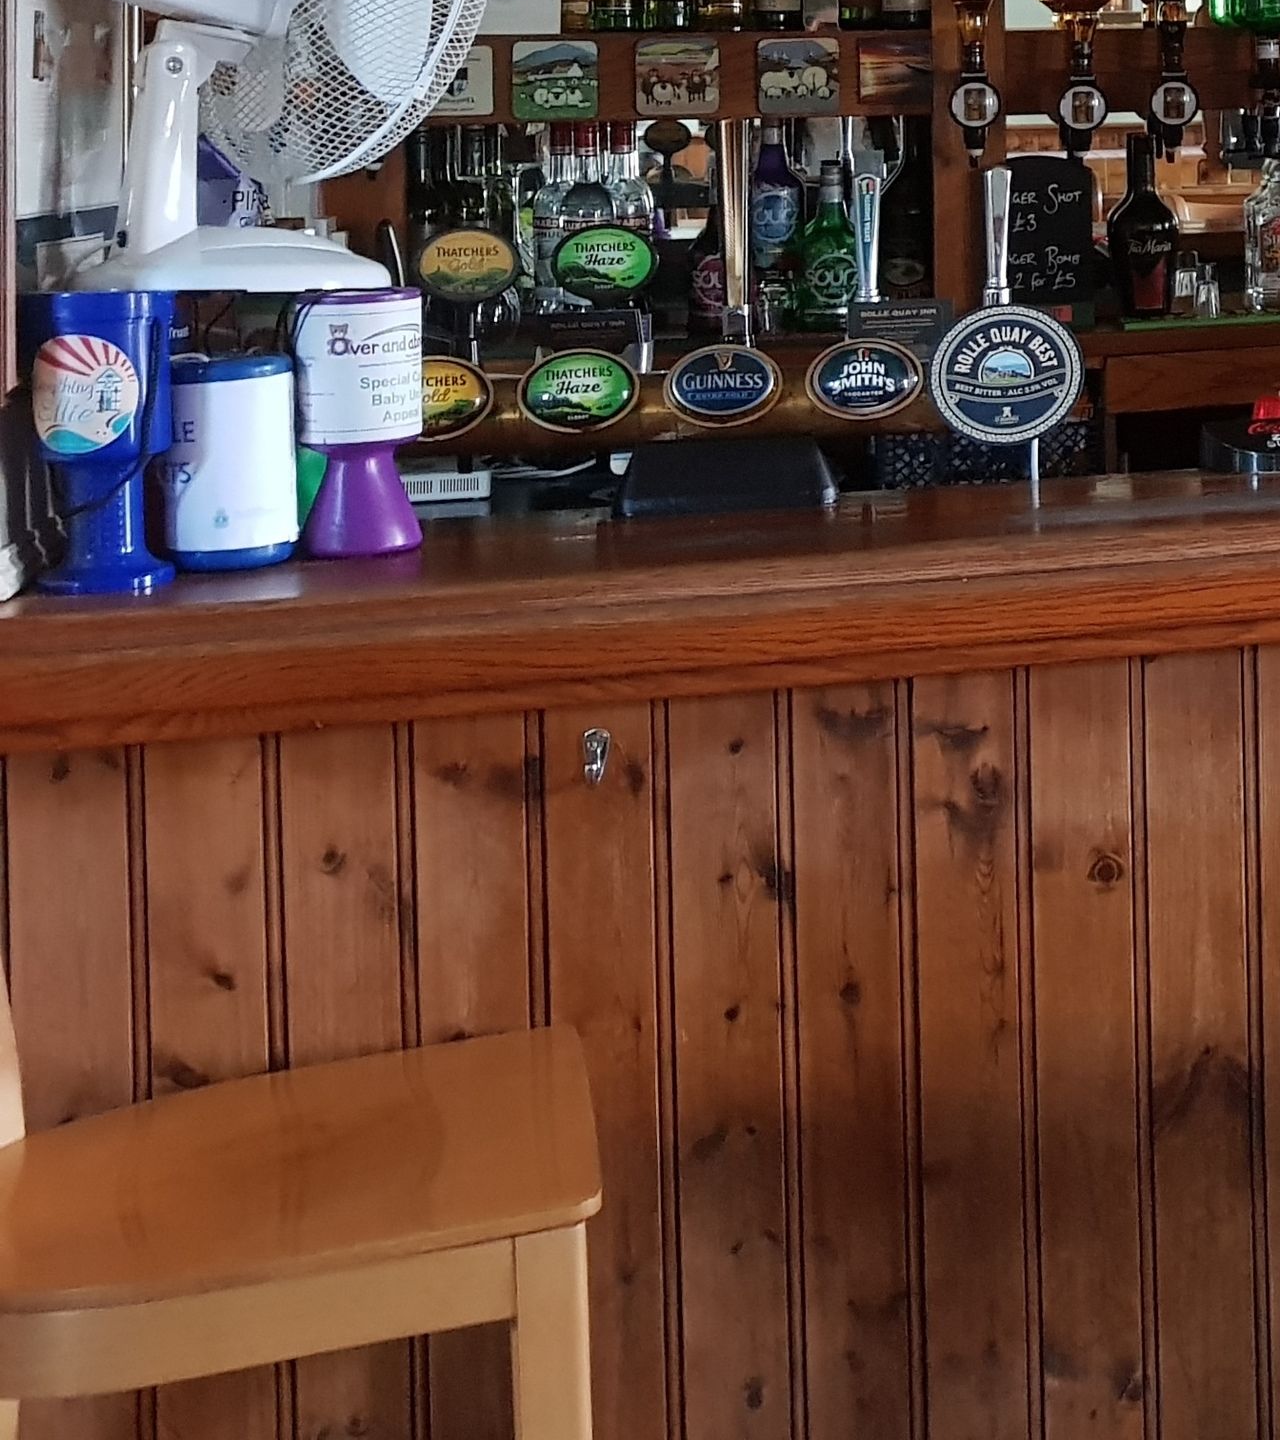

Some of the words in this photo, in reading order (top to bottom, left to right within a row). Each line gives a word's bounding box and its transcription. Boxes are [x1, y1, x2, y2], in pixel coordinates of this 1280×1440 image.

[1043, 183, 1082, 215] SHOT
[1012, 212, 1038, 233] £3
[435, 245, 499, 258] THATCHERS
[574, 241, 636, 253] THATCHERS
[584, 252, 627, 267] Haze
[1013, 272, 1024, 289] 2
[1052, 270, 1076, 290] £5
[331, 337, 379, 356] Over
[382, 335, 407, 353] and
[954, 332, 990, 374] ROLLE
[990, 326, 1032, 344] QUAY
[1028, 335, 1059, 368] BEST
[544, 364, 613, 381] THATCHERS
[840, 361, 886, 378] JOHN
[360, 373, 411, 391] Special
[422, 374, 467, 388] TCHERS
[555, 379, 602, 396] Haze
[682, 372, 763, 390] GUINNESS
[422, 387, 451, 404] old
[954, 383, 975, 394] BEST
[974, 386, 1002, 397] BITTER
[371, 391, 407, 407] Baby
